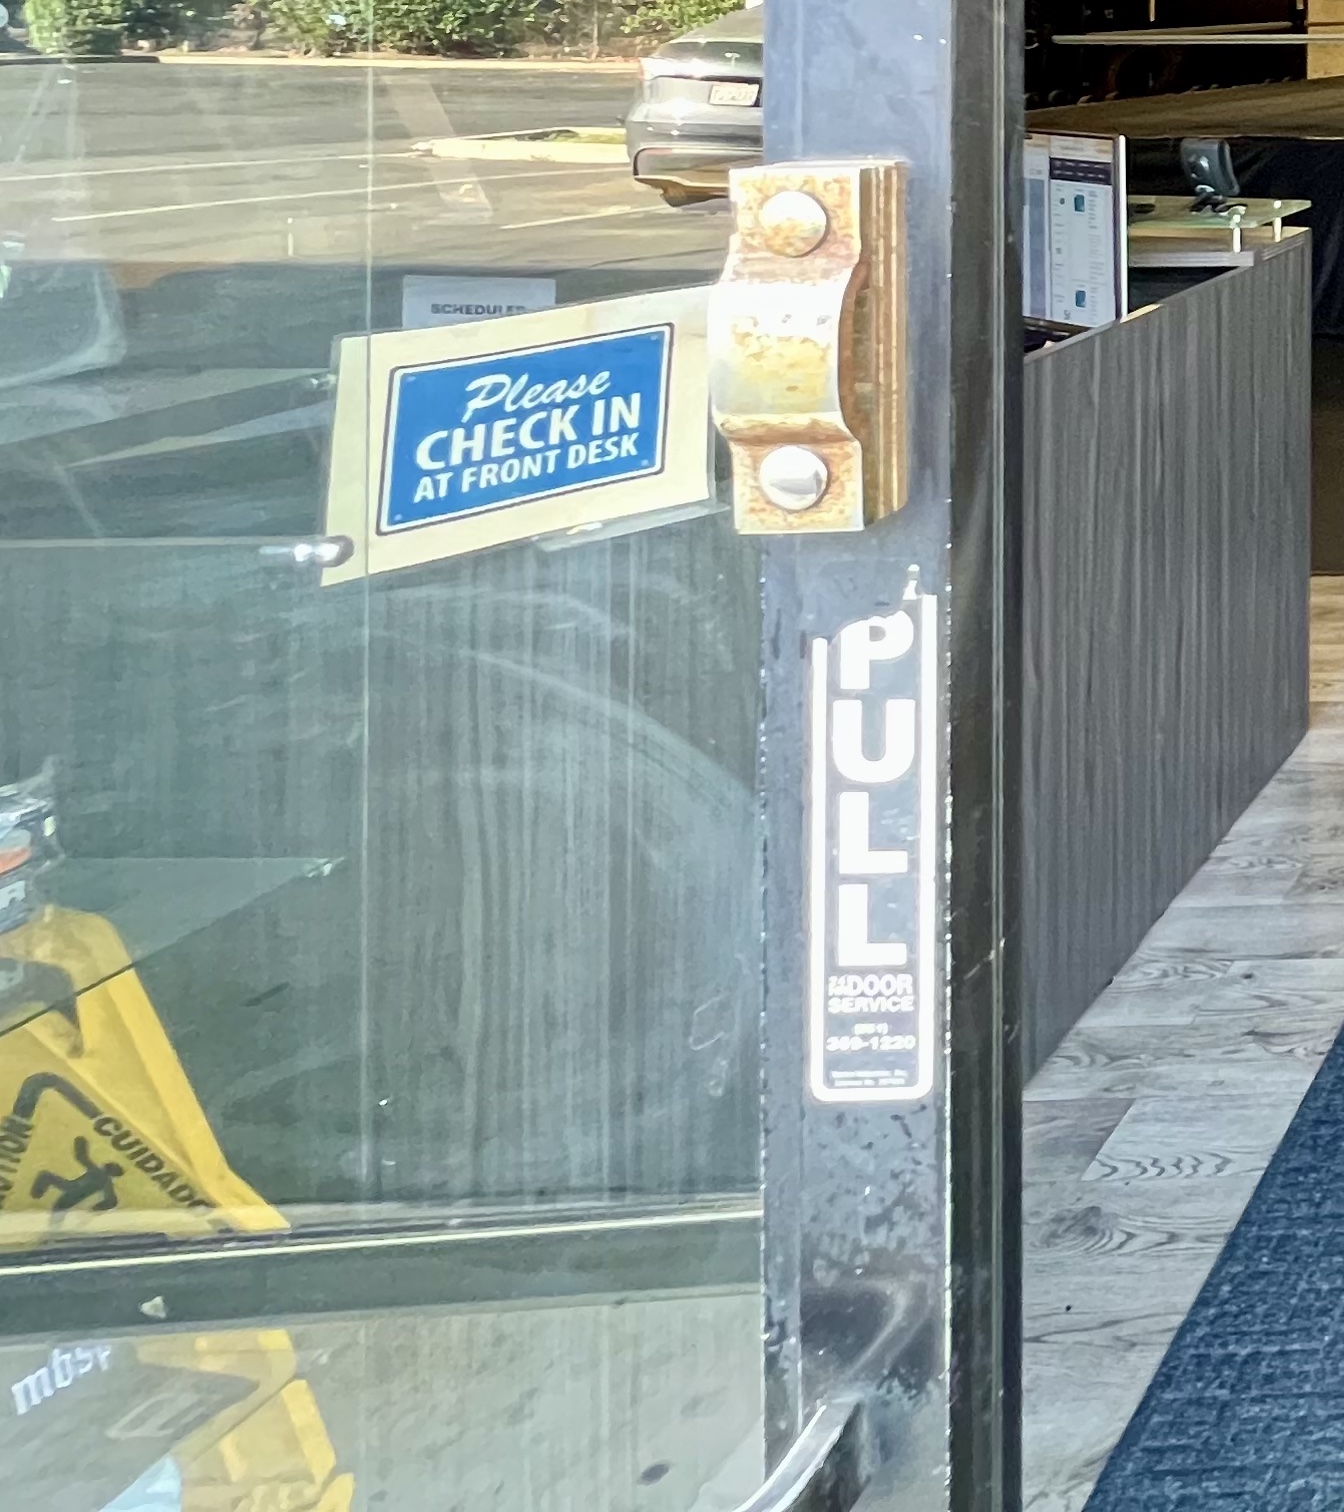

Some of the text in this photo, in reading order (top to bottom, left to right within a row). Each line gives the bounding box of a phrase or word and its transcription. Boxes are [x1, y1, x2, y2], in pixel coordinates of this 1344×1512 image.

[415, 392, 642, 471] CHECK IN
[461, 370, 612, 424] Please
[413, 432, 640, 504] AT FRONT DESK
[832, 609, 916, 967] PULL
[827, 996, 915, 1014] SERVICE
